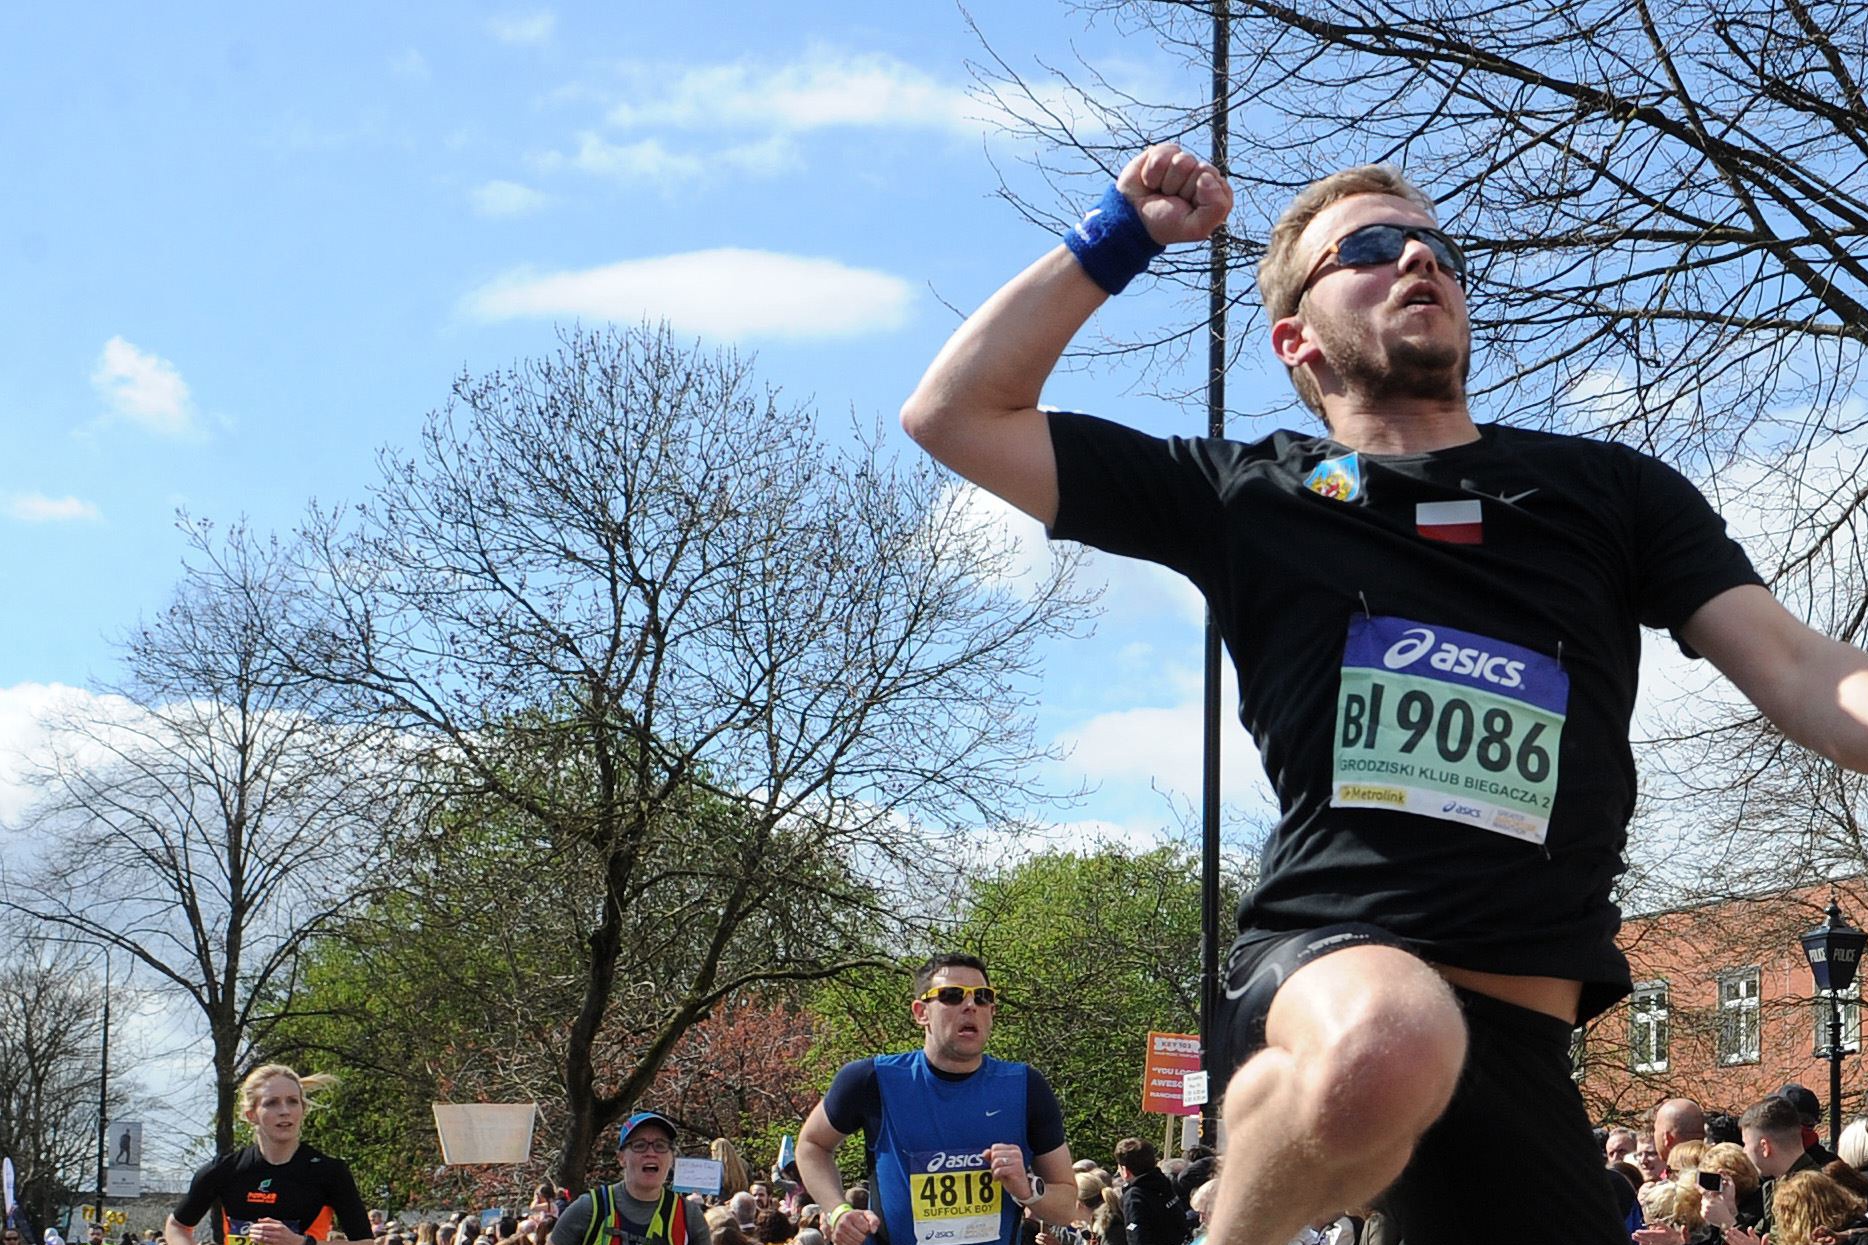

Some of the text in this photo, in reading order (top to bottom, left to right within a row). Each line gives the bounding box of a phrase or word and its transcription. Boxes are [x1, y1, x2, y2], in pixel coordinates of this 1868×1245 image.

[1430, 641, 1527, 690] asics
[1339, 759, 1414, 776] GRODZISKI
[1418, 767, 1459, 785] KLUB
[1464, 777, 1538, 806] BIEGACZA
[1351, 787, 1406, 804] Metrolink
[1808, 947, 1828, 962] POLICE
[1833, 948, 1856, 962] POLICE
[945, 1154, 984, 1168] asics
[920, 1171, 994, 1207] 4818
[923, 1204, 993, 1217] SUFFOLK BOY
